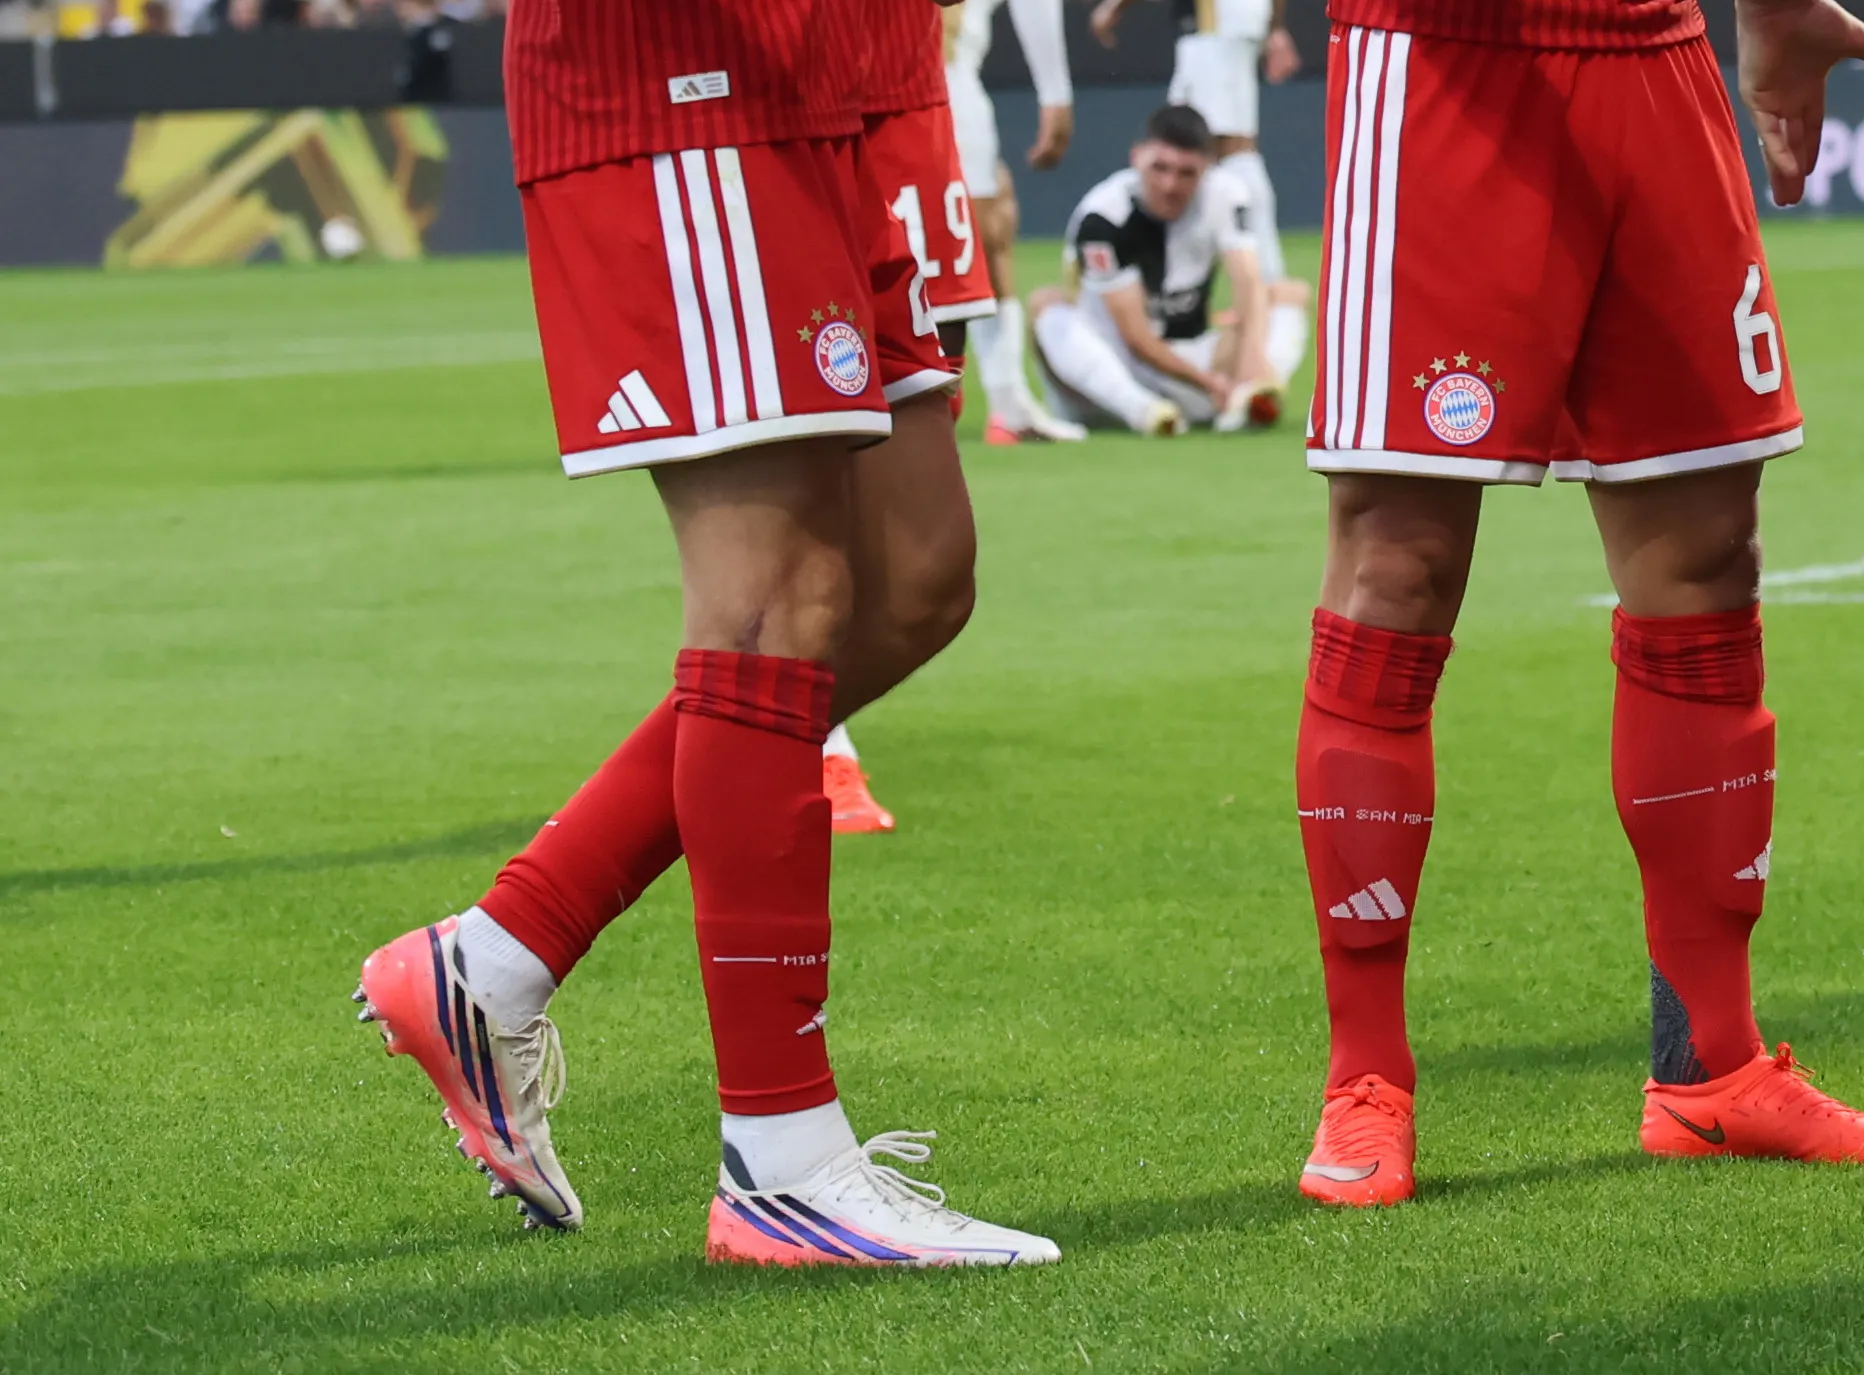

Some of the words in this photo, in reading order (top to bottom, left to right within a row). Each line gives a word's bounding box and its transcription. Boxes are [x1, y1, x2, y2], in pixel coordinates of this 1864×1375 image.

[891, 180, 974, 278] 19
[1733, 264, 1783, 396] 6
[1431, 386, 1446, 402] FC
[1445, 378, 1490, 407] BAYERN
[1722, 773, 1757, 792] MIA
[1315, 806, 1345, 821] MIA
[1355, 808, 1397, 823] SAN
[1402, 812, 1422, 825] MIA
[783, 955, 817, 966] MIA
